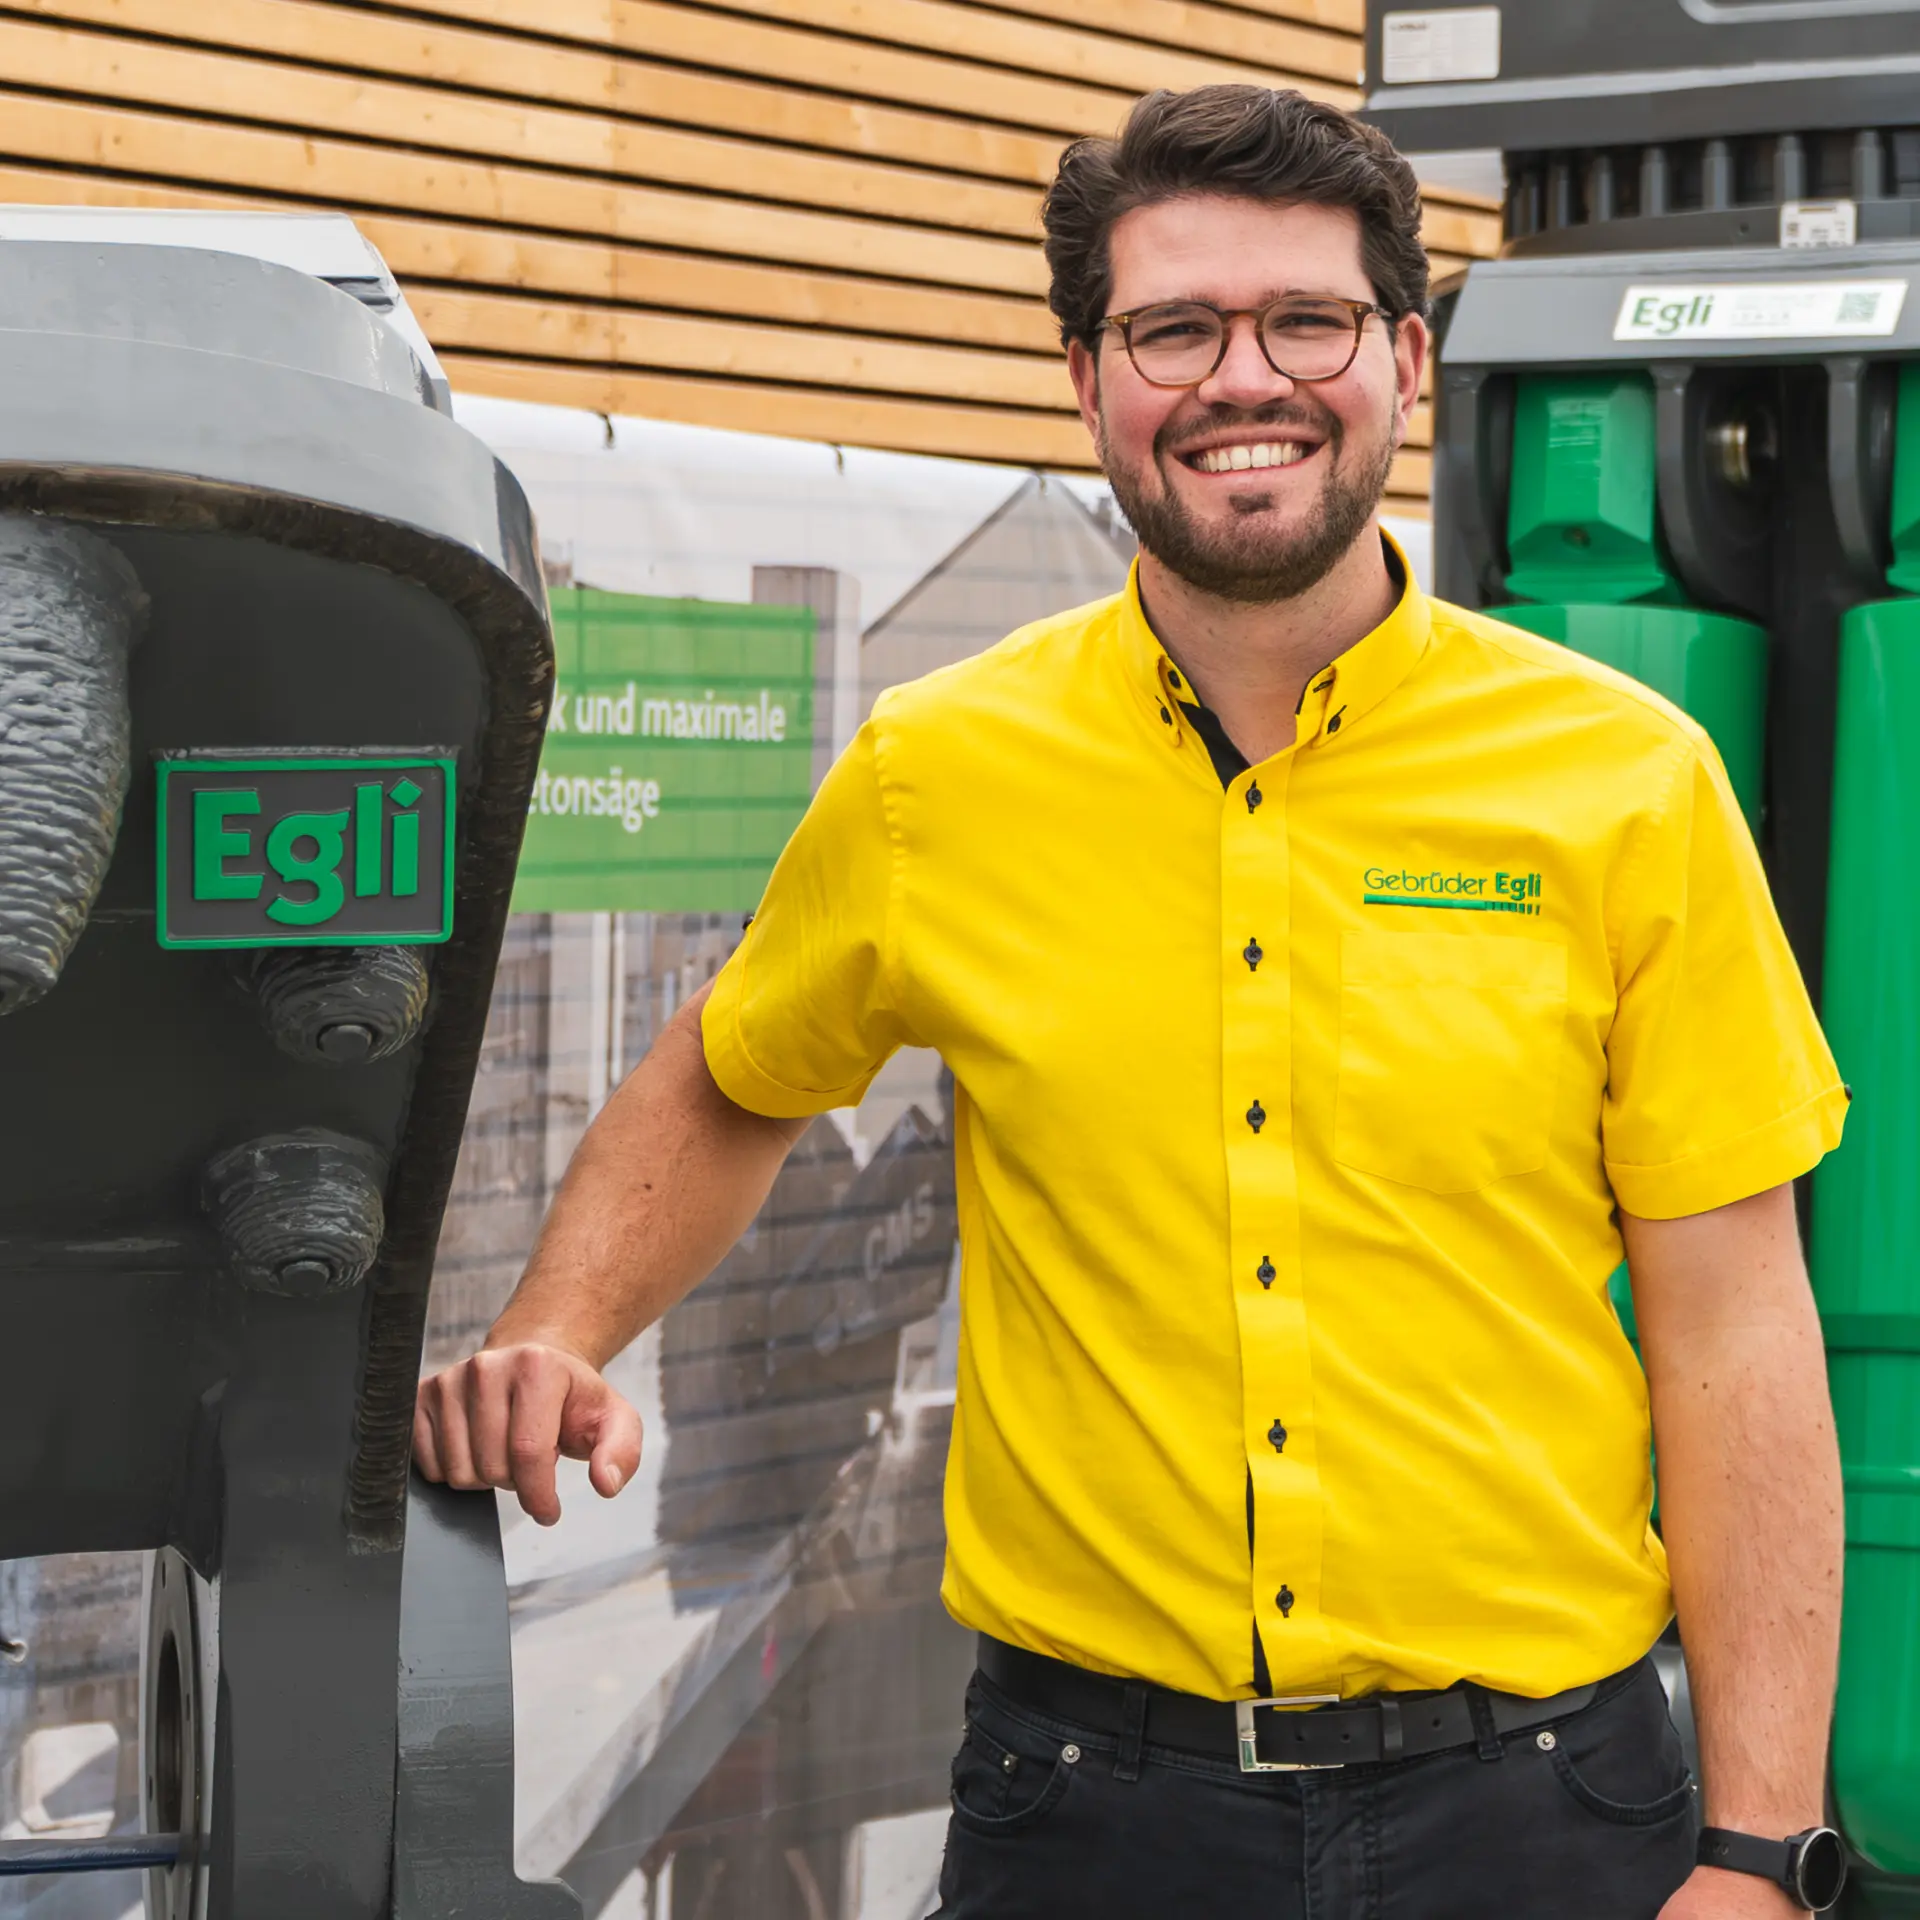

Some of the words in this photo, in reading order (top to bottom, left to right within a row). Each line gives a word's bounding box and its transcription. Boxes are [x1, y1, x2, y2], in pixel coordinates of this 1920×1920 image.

[1630, 293, 1715, 336] Egli
[575, 682, 637, 736] und
[642, 689, 786, 742] maximale
[193, 778, 422, 926] Egli
[1363, 868, 1487, 895] Gebrüder
[1495, 872, 1542, 900] Egli
